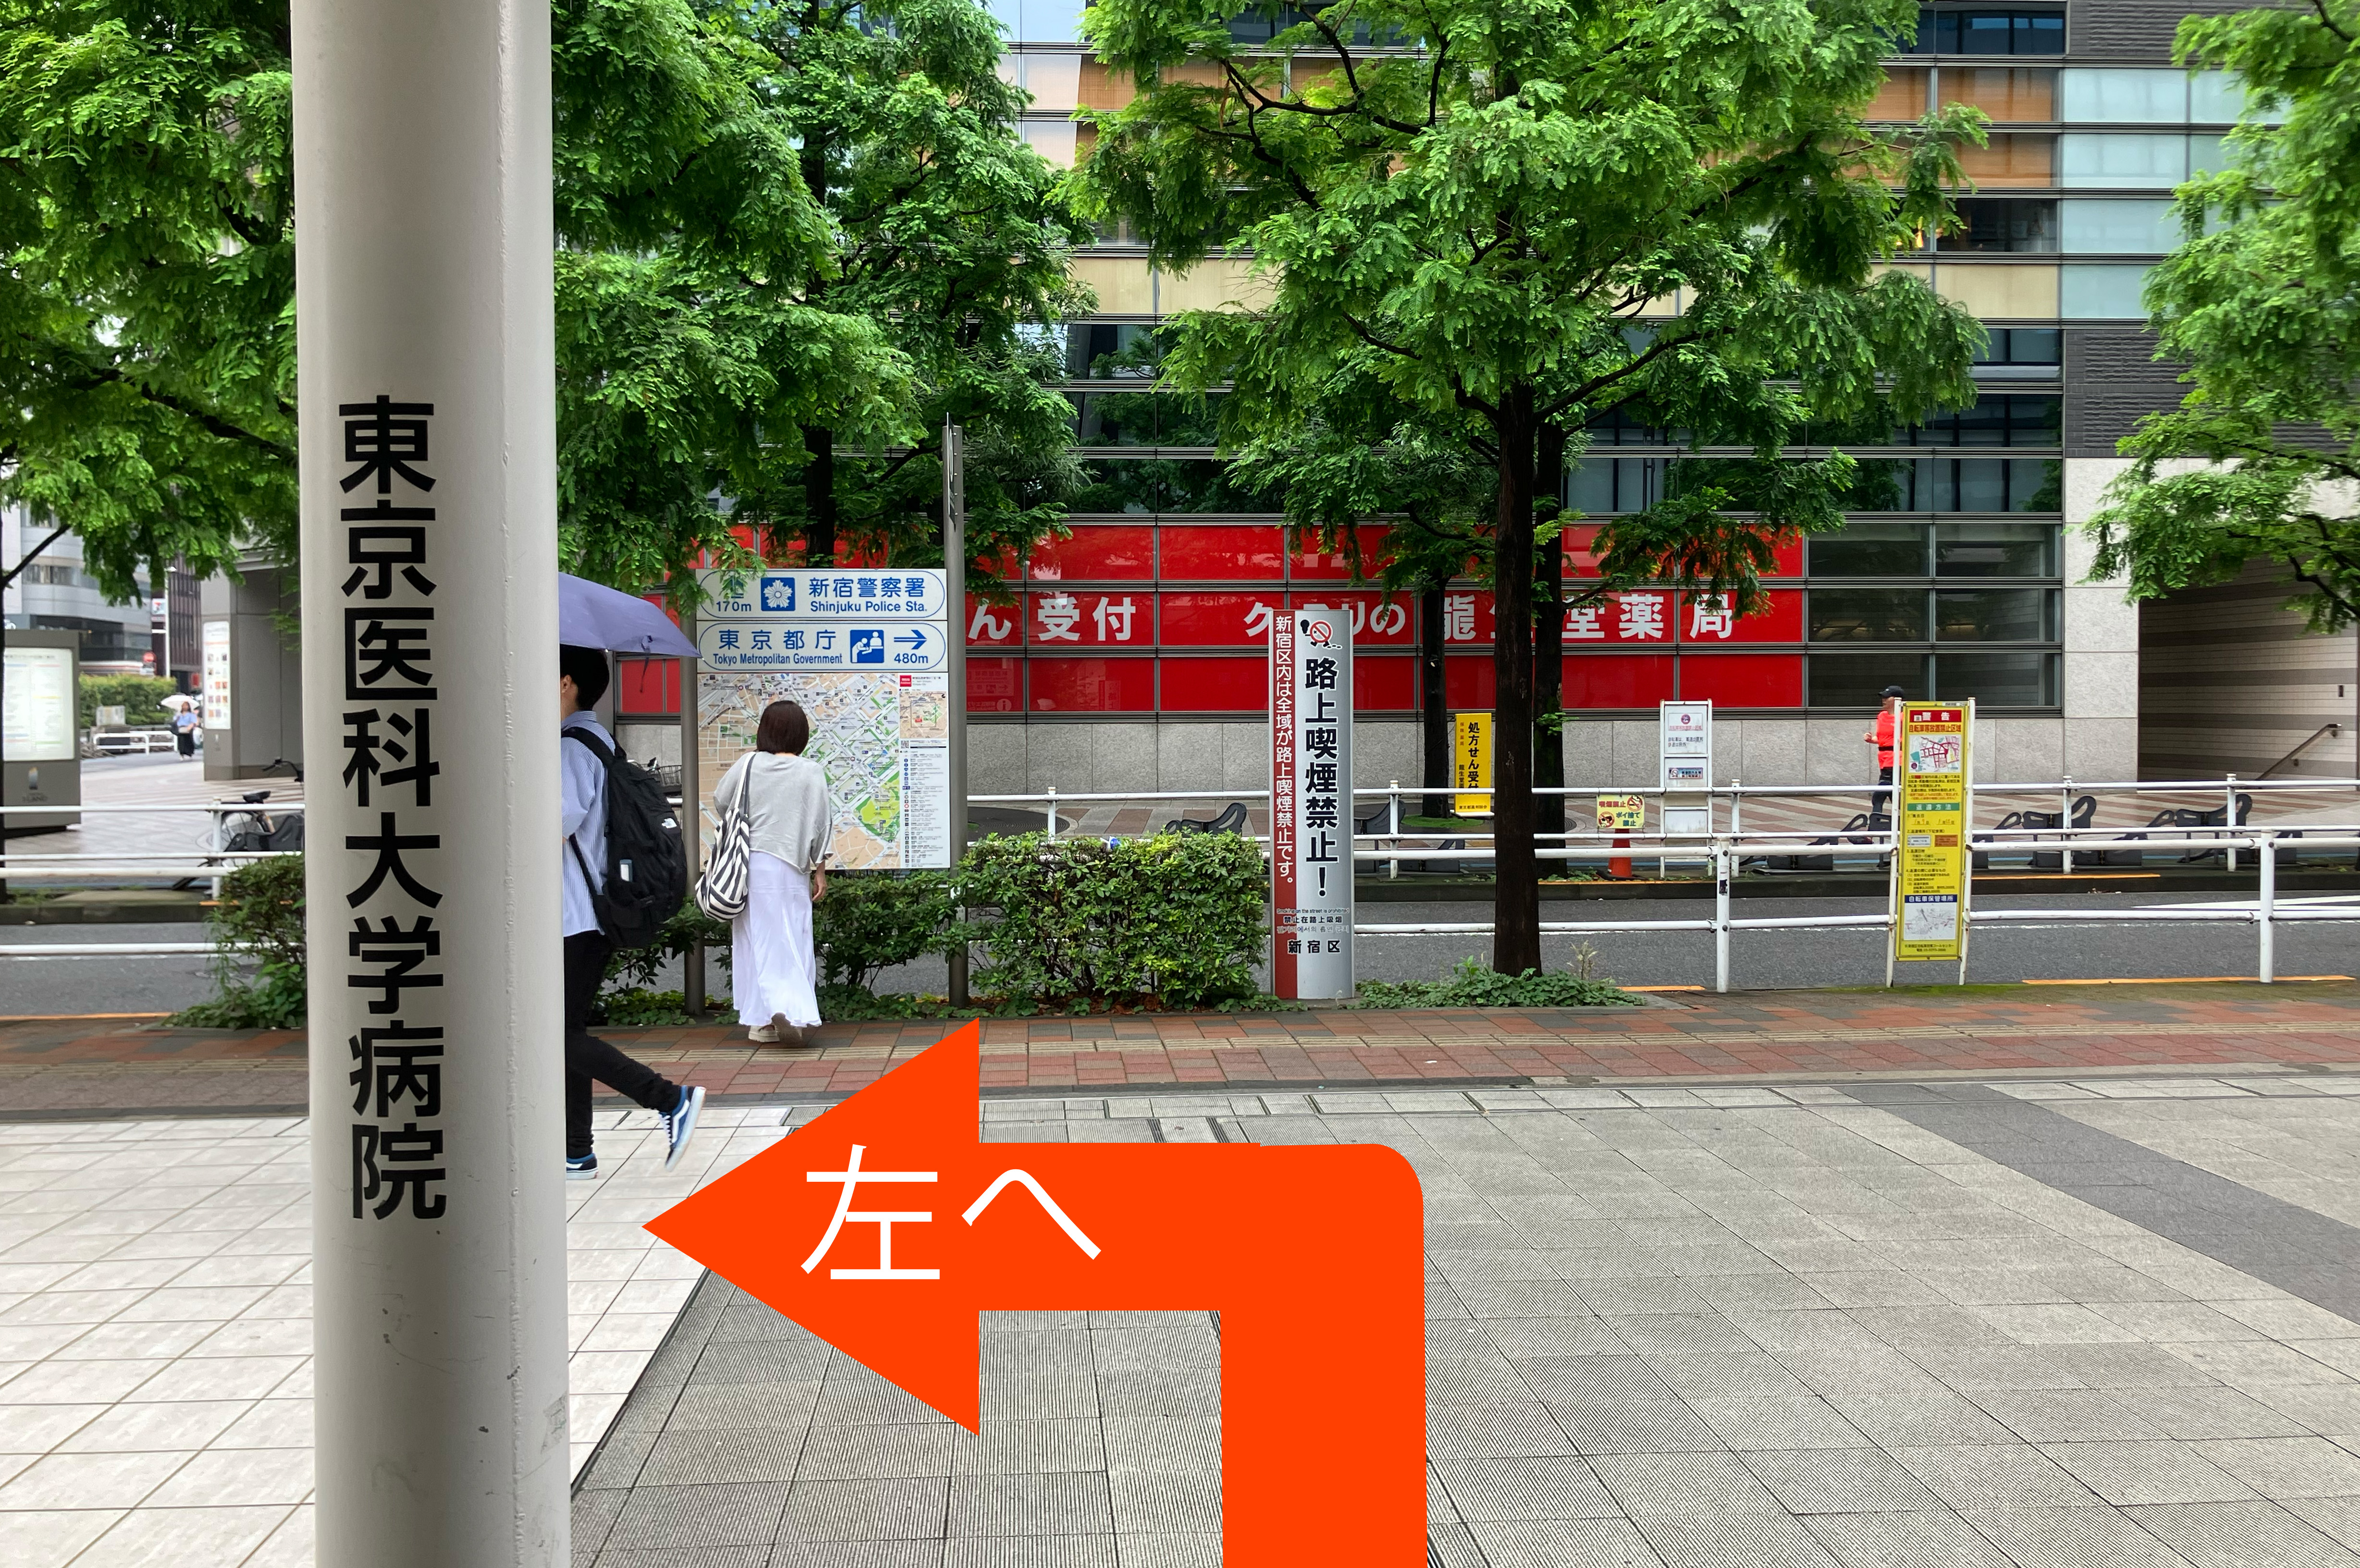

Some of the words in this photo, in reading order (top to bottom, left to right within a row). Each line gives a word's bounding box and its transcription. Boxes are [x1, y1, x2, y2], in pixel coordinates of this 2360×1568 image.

[809, 577, 925, 598] 新宿警察署
[716, 601, 751, 612] 170m
[811, 601, 861, 614] Shinjuku
[865, 600, 901, 612] Police
[906, 601, 927, 612] Sta.
[718, 629, 836, 650] 東京都庁
[713, 653, 738, 665] Tokyo
[740, 653, 790, 665] Metropolitan
[793, 654, 843, 664] Government
[894, 653, 929, 664] 480m
[1276, 615, 1293, 883] 新宿区内は全域が路上喫煙禁止です。
[339, 394, 446, 1221] 東京医科大学病院
[1288, 939, 1341, 954] 新宿区
